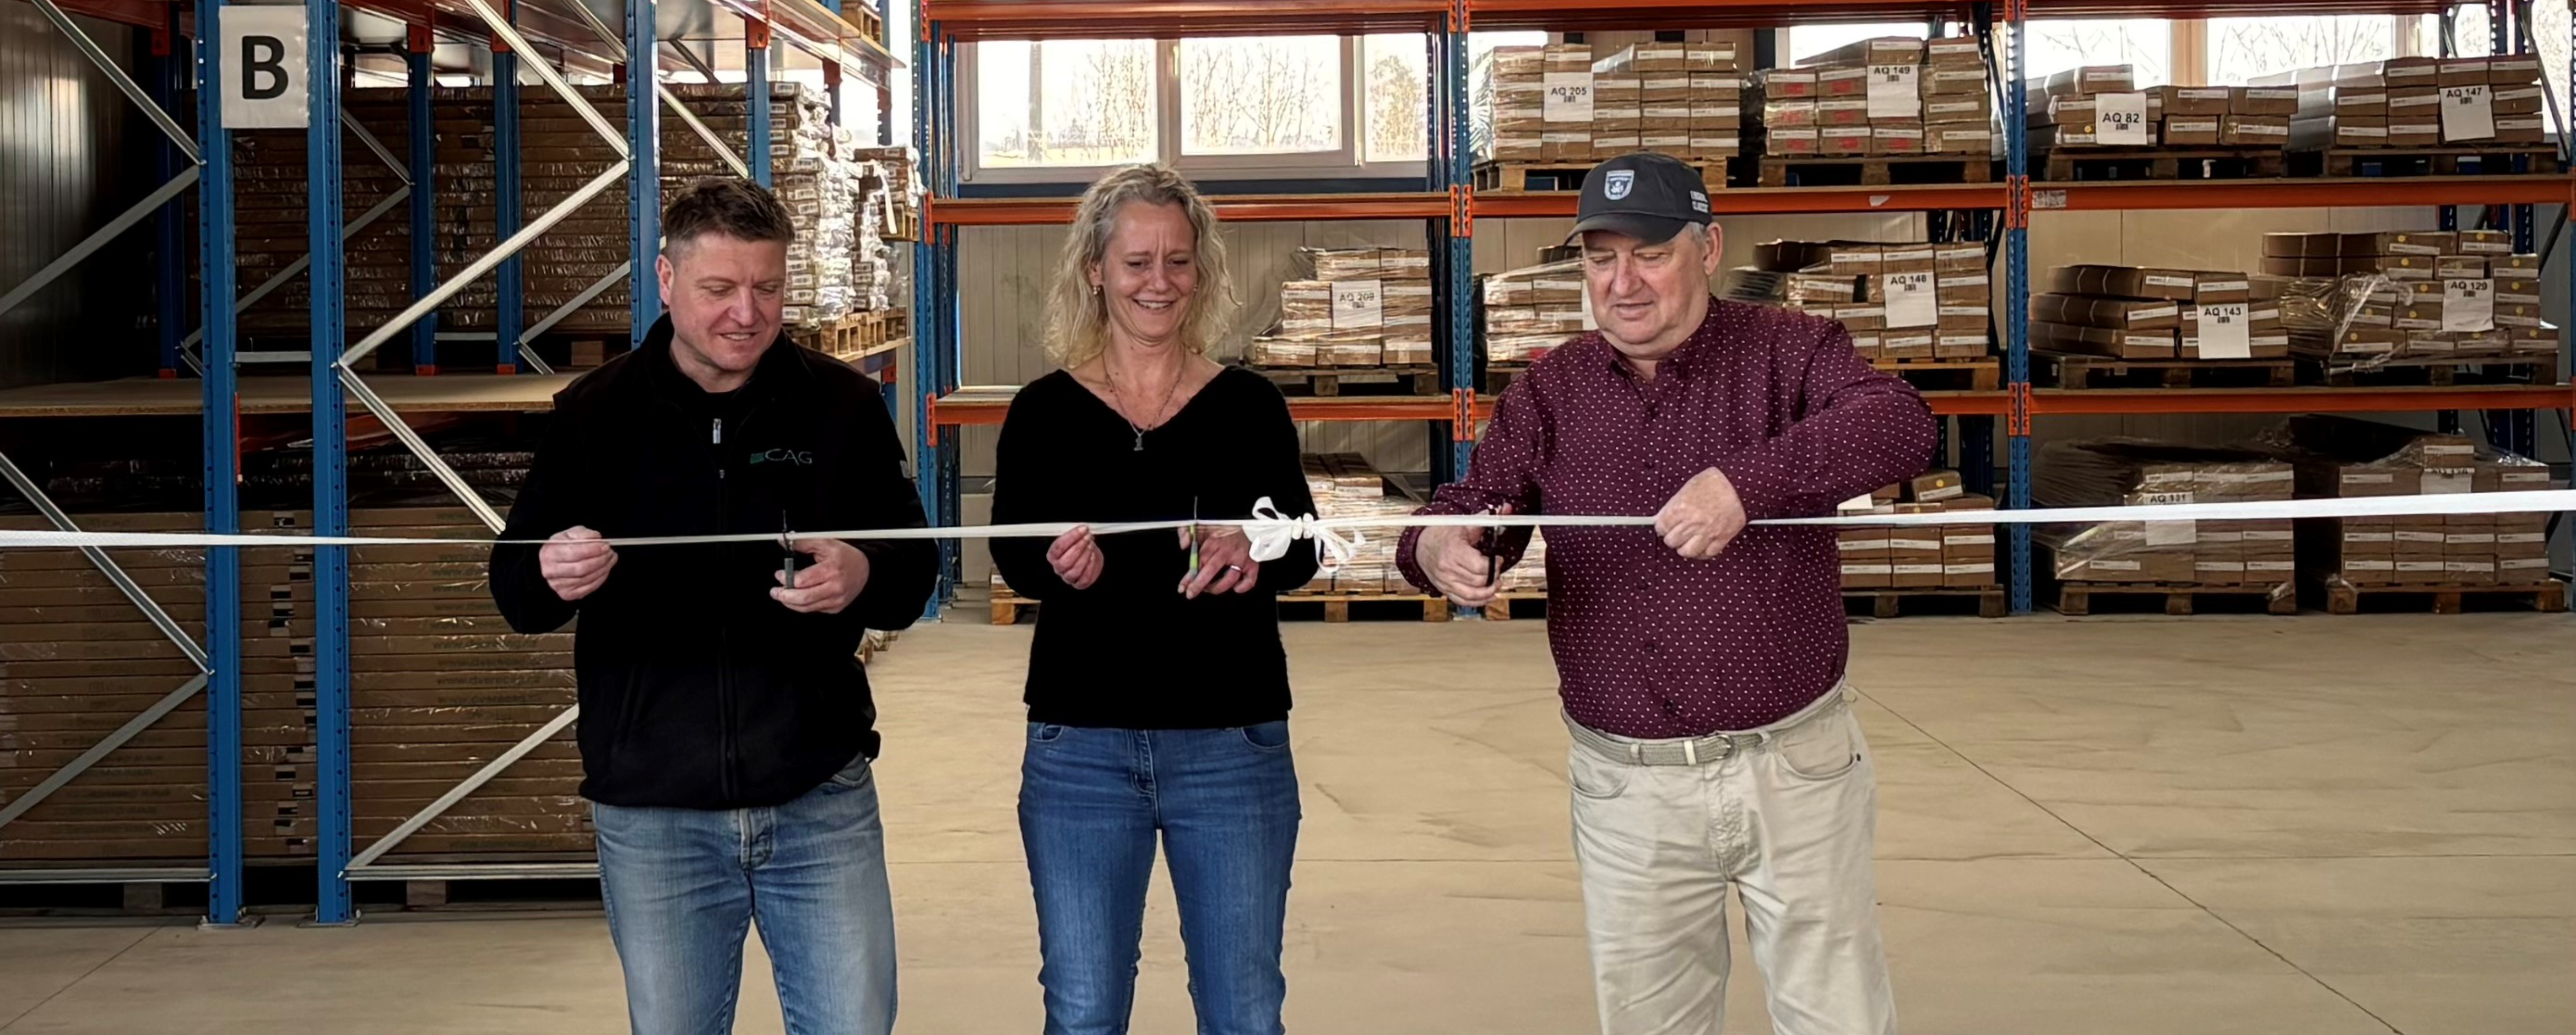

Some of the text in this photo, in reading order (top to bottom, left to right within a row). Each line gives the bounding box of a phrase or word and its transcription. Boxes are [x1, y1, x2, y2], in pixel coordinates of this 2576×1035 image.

[242, 35, 289, 99] B
[1873, 66, 1910, 75] AQ 149
[1551, 87, 1587, 96] AQ 205
[2446, 87, 2483, 99] AQ 147
[2102, 112, 2139, 124] AQ 82
[1890, 276, 1906, 285] AQ
[2450, 281, 2467, 290] AQ
[1339, 293, 1355, 302] AQ
[2204, 307, 2241, 316] AQ 143
[765, 448, 812, 466] CAG
[2150, 495, 2166, 503] AQ
